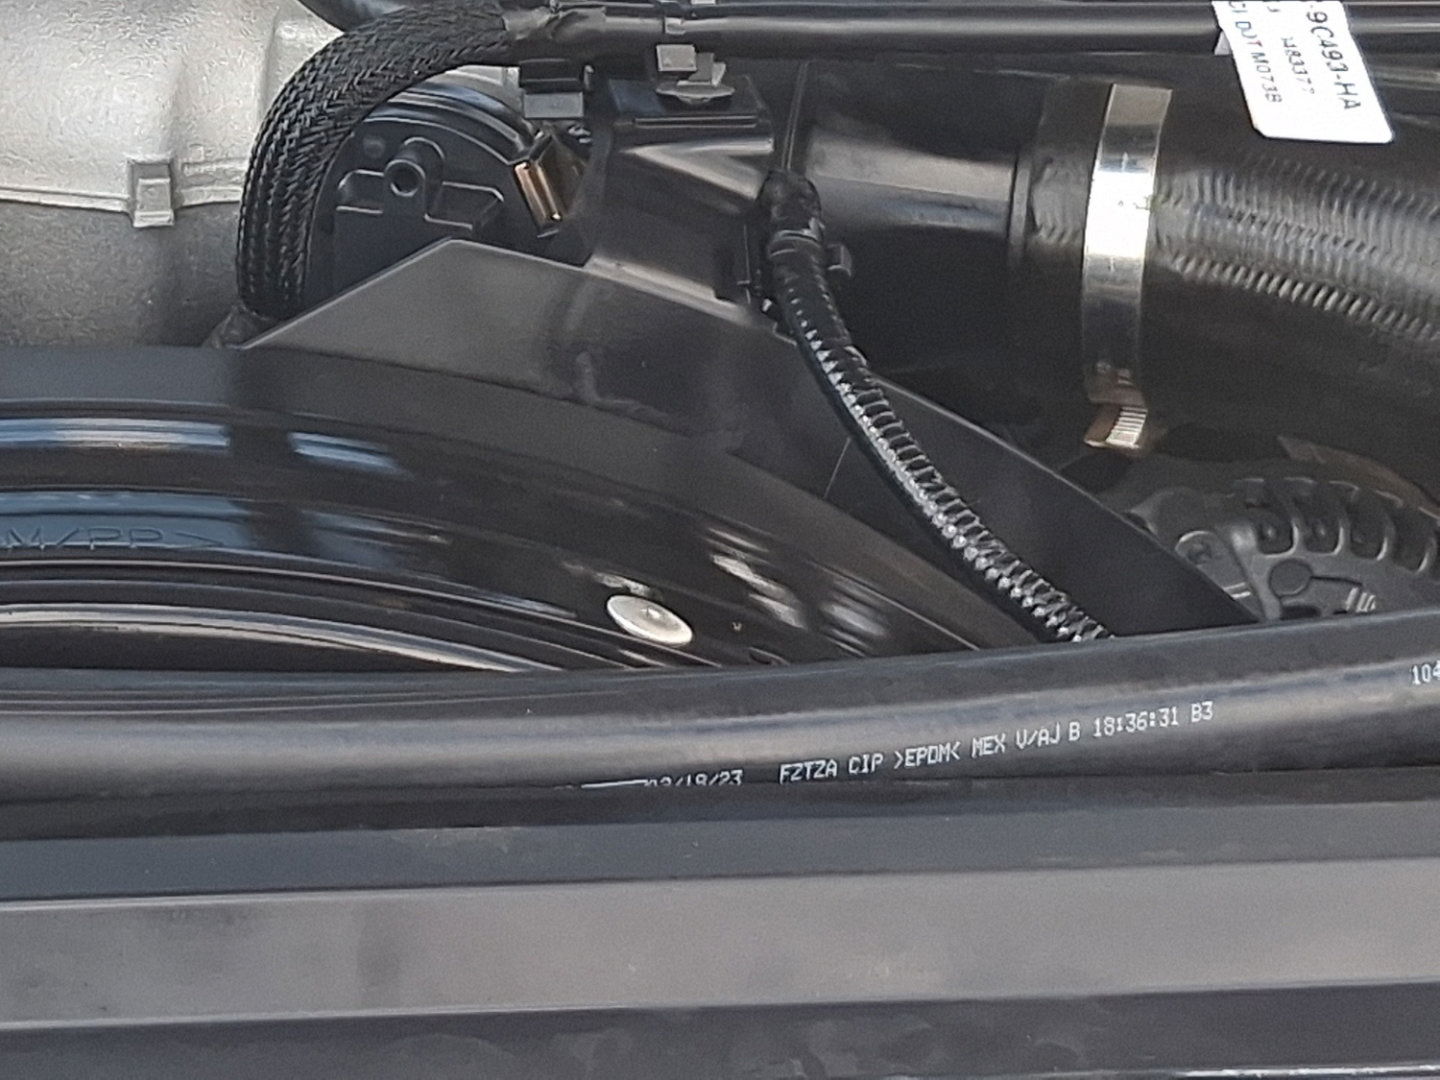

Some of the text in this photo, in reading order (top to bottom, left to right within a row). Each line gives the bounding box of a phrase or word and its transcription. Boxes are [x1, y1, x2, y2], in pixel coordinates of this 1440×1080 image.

[848, 753, 884, 775] CIP
[972, 734, 1007, 759] MEX
[1068, 721, 1082, 742] B
[1093, 706, 1179, 739] 18:36:31
[1190, 701, 1215, 722] B3
